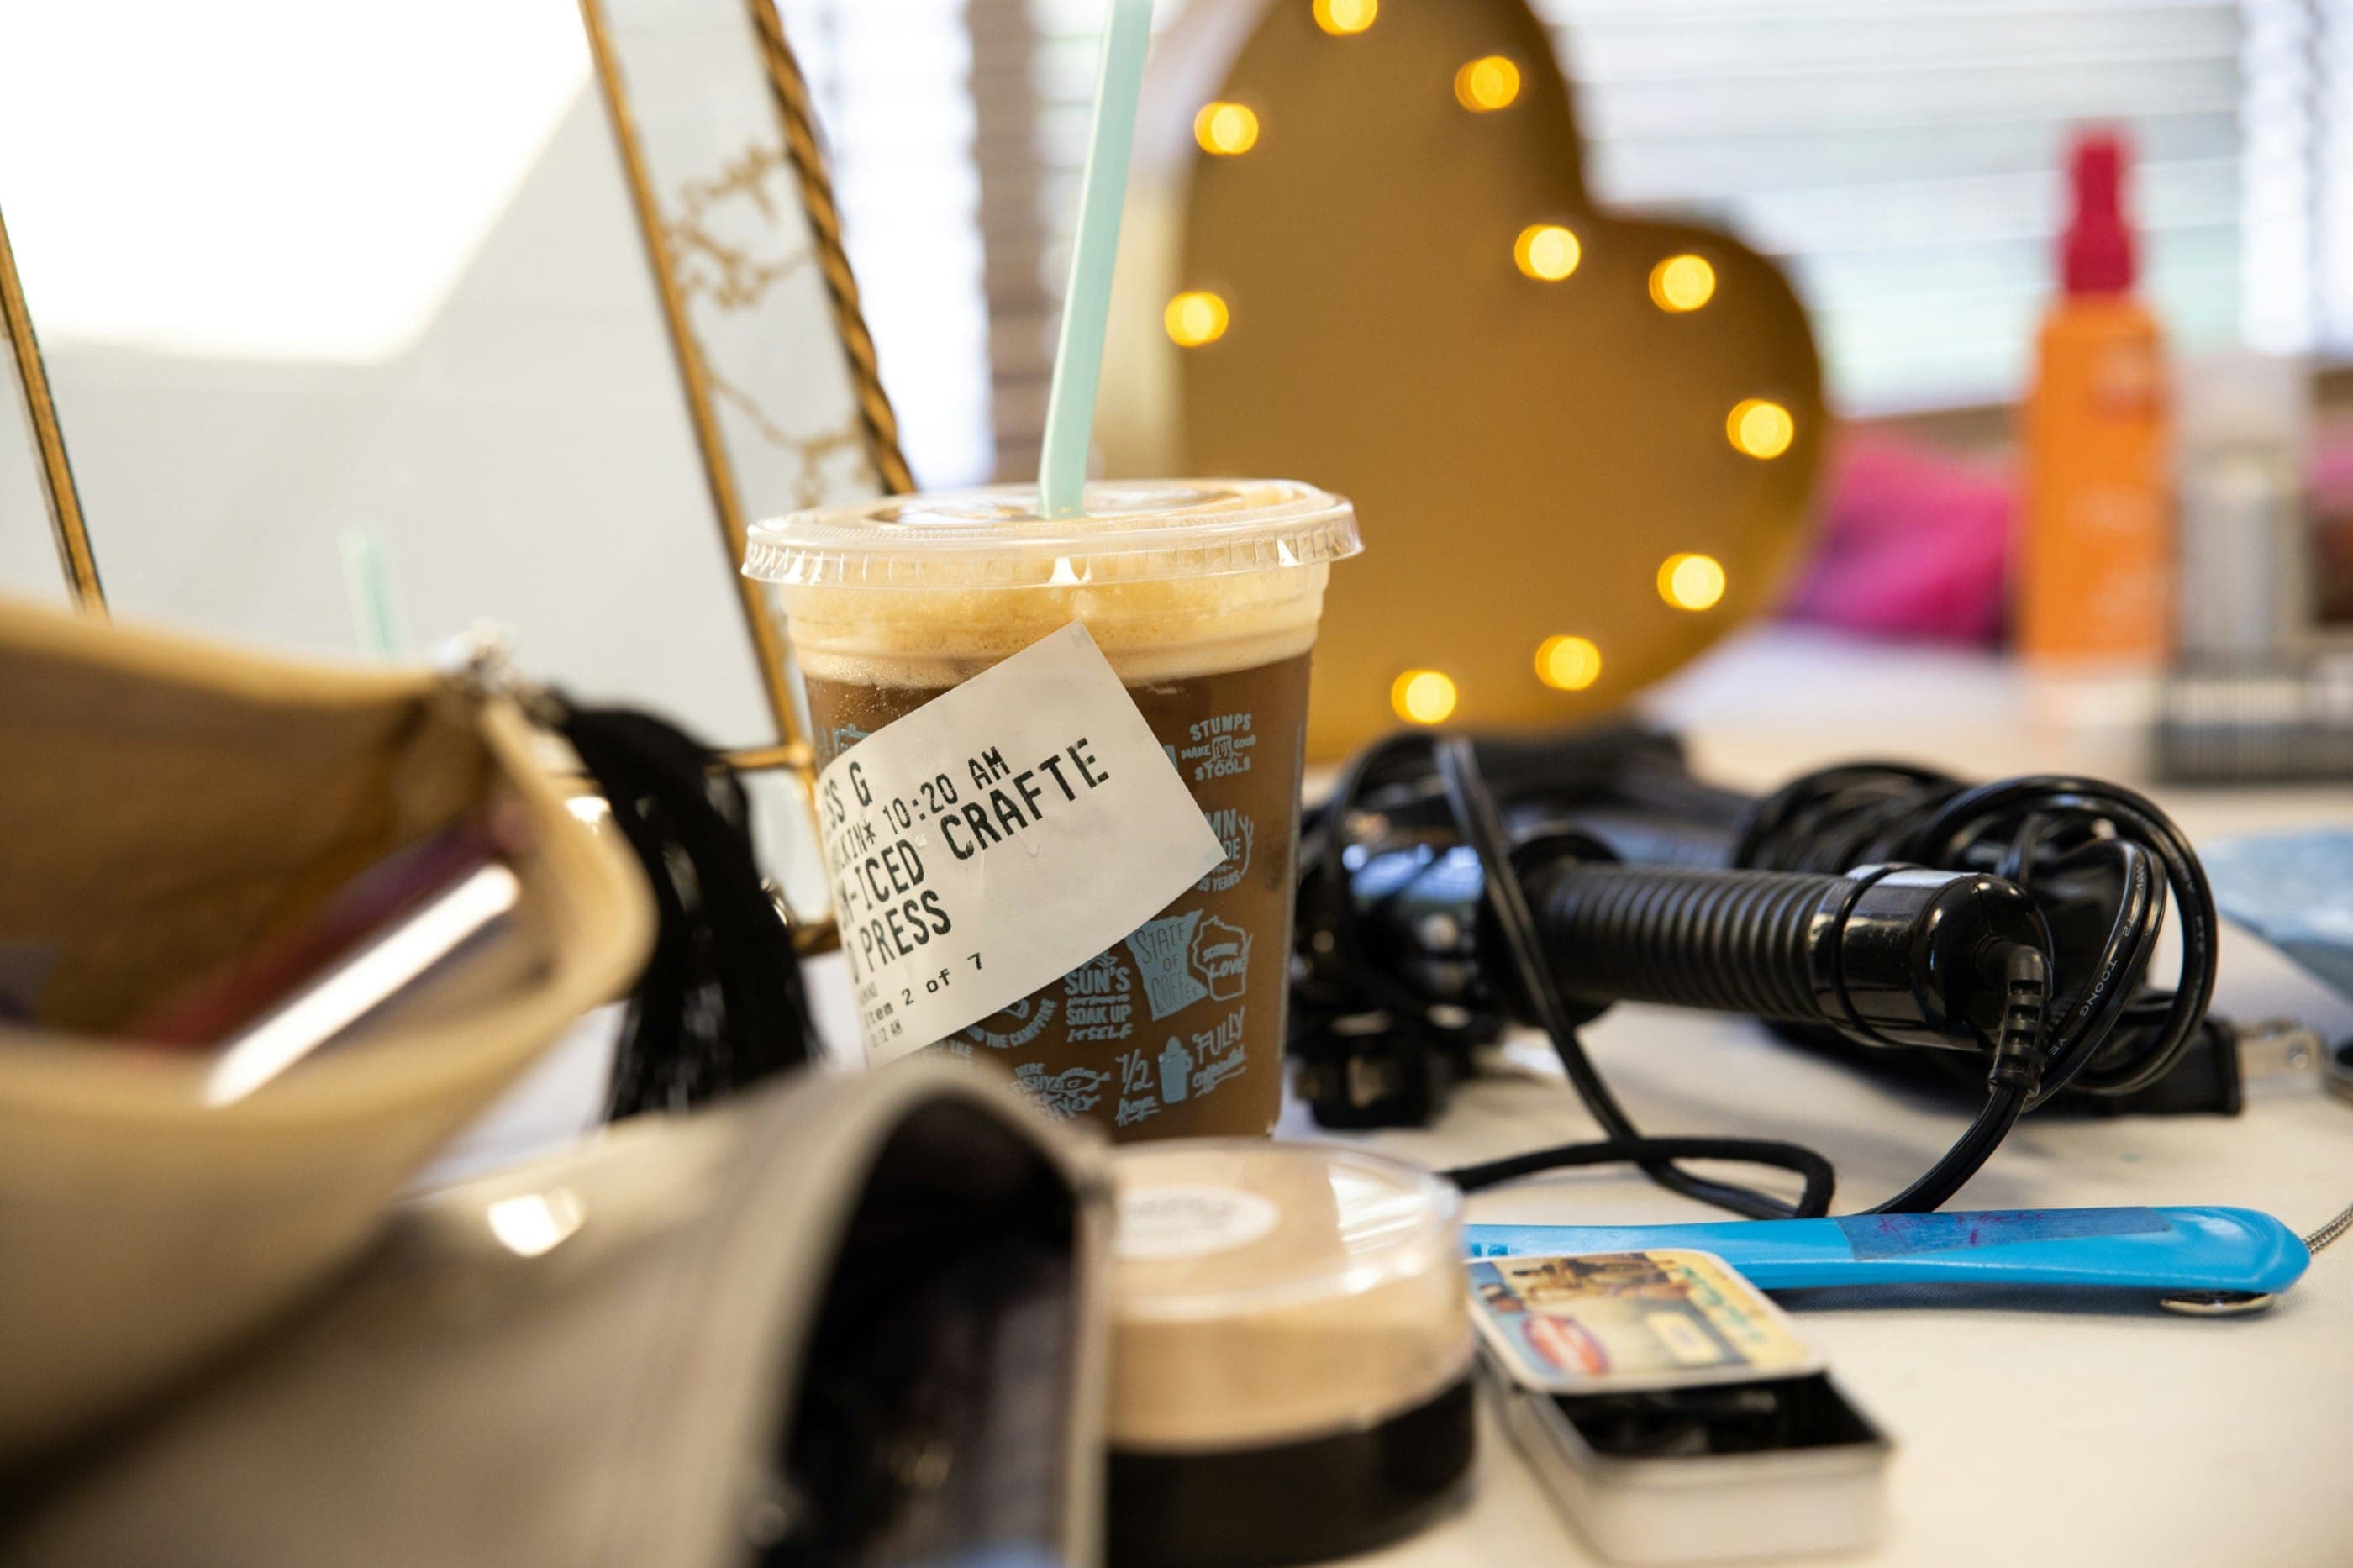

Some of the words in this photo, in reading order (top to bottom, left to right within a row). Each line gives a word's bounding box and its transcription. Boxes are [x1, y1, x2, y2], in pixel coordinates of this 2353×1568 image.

[1181, 745, 1211, 760] MAKE
[1233, 734, 1256, 750] GOOD
[1189, 713, 1252, 741] STUMPS
[849, 760, 874, 807] G
[882, 772, 959, 834] 10:20
[967, 745, 1012, 790] AM
[1194, 756, 1251, 781] STOOLS
[939, 736, 1111, 861] CRAFTE
[859, 889, 952, 974] PRESS
[1134, 920, 1187, 966] STATE
[901, 987, 915, 1007] 2
[926, 967, 952, 995] of
[966, 951, 984, 971] 7
[1063, 966, 1131, 996] SUN'S
[1163, 955, 1180, 971] OF
[1150, 970, 1200, 1014] COFFEE
[2079, 959, 2119, 1018] TOONG
[1066, 1006, 1108, 1026] SOAK
[1110, 1003, 1132, 1023] UP
[1191, 1004, 1245, 1065] FULLY
[985, 1034, 1009, 1049] THE
[1114, 1048, 1155, 1095] 1/2
